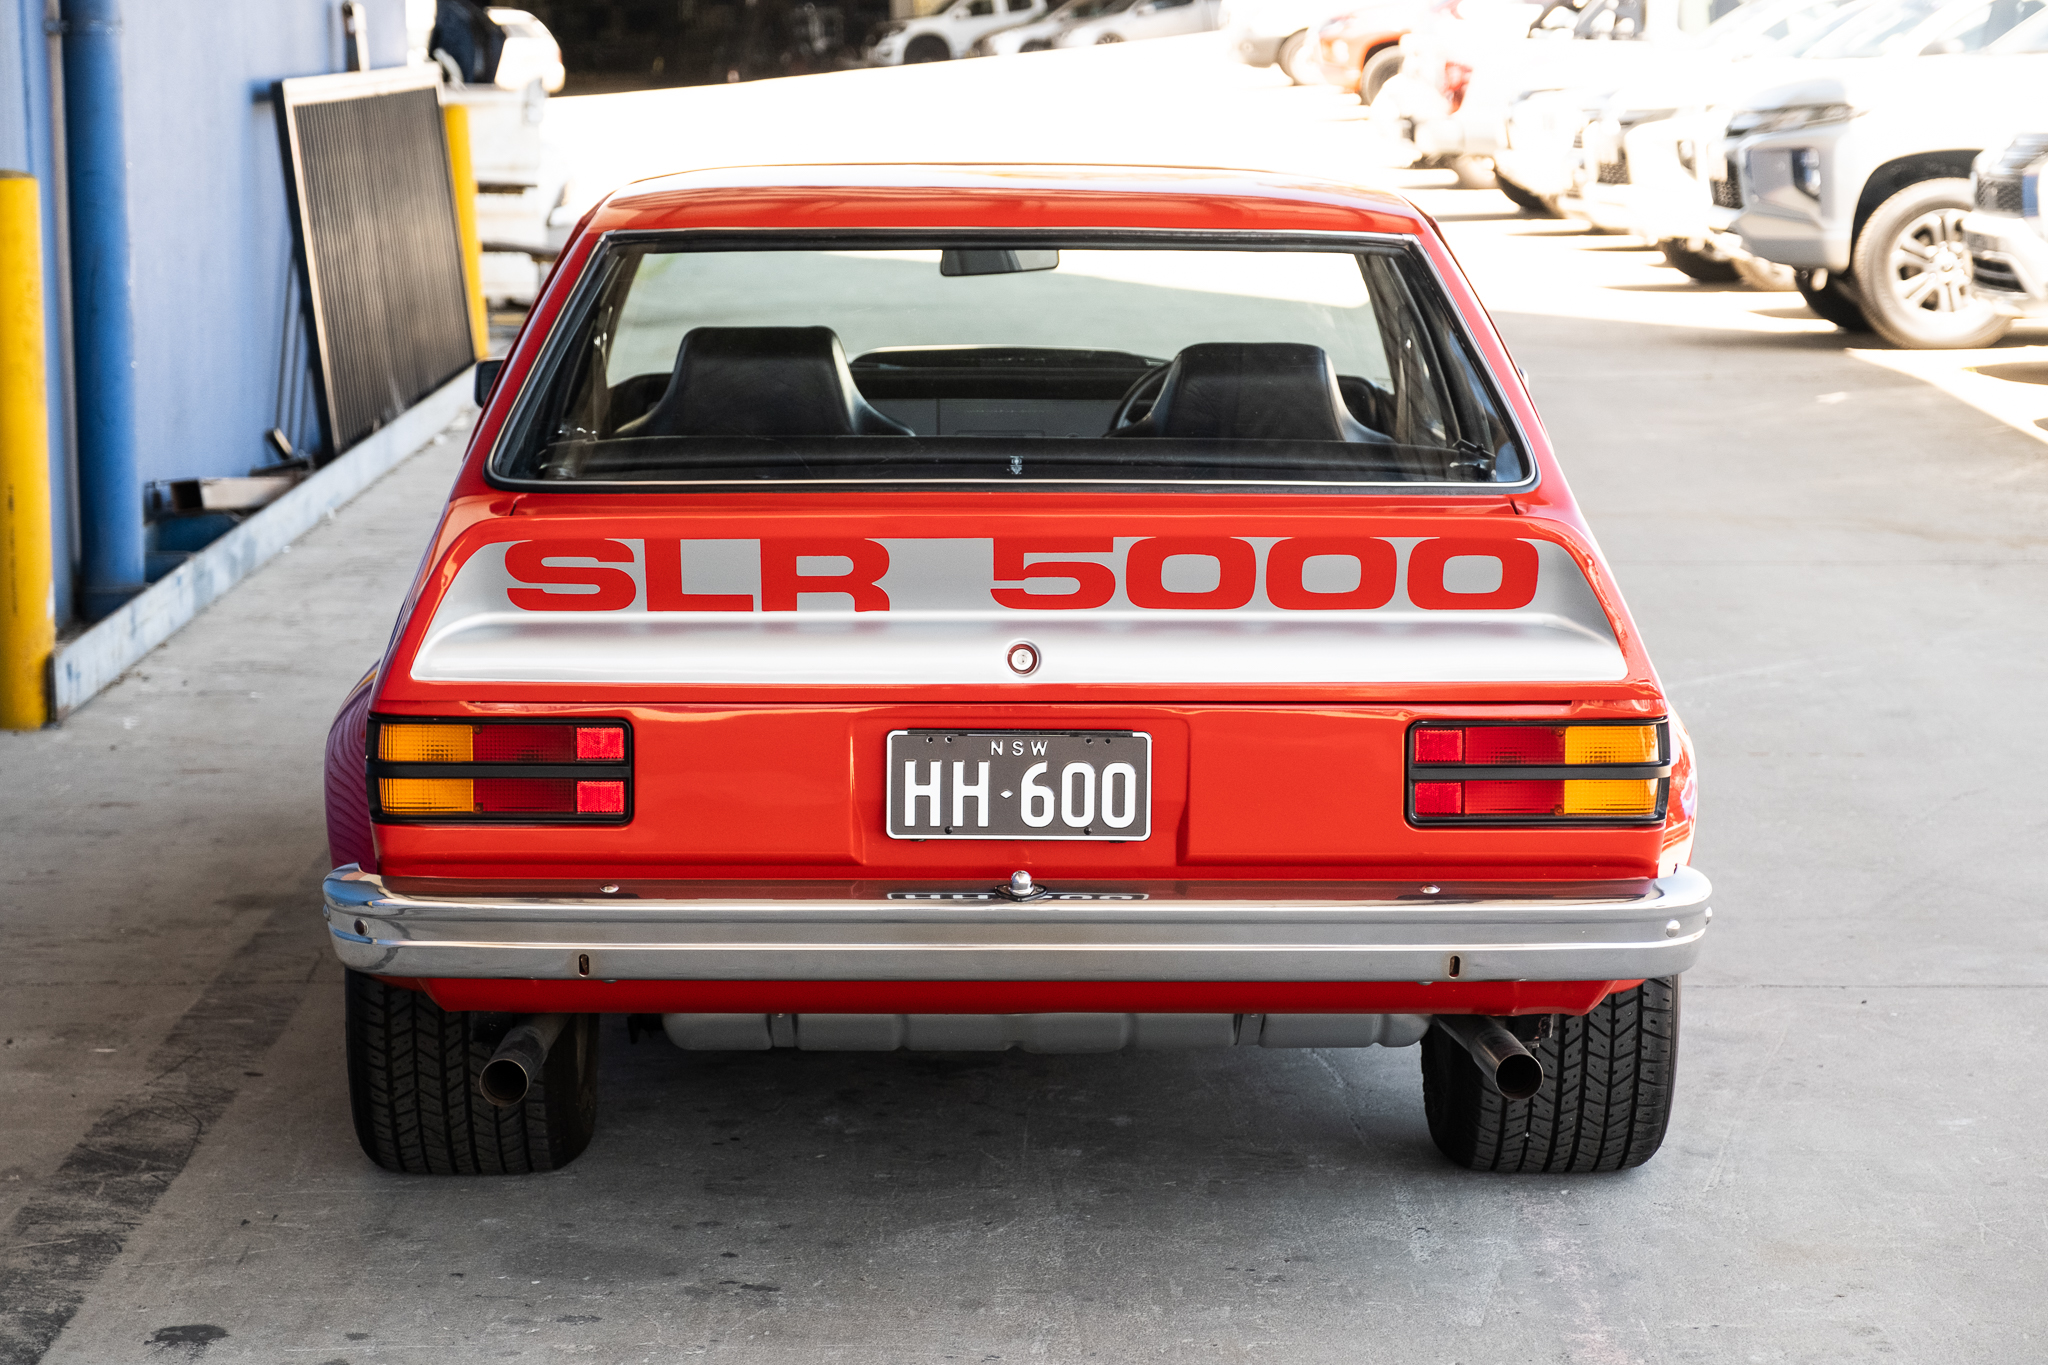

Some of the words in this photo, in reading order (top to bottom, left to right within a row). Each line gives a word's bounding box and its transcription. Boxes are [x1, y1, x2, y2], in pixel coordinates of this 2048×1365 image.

[504, 538, 890, 611] SLR
[990, 536, 1539, 610] 5000
[990, 740, 1049, 756] NSW
